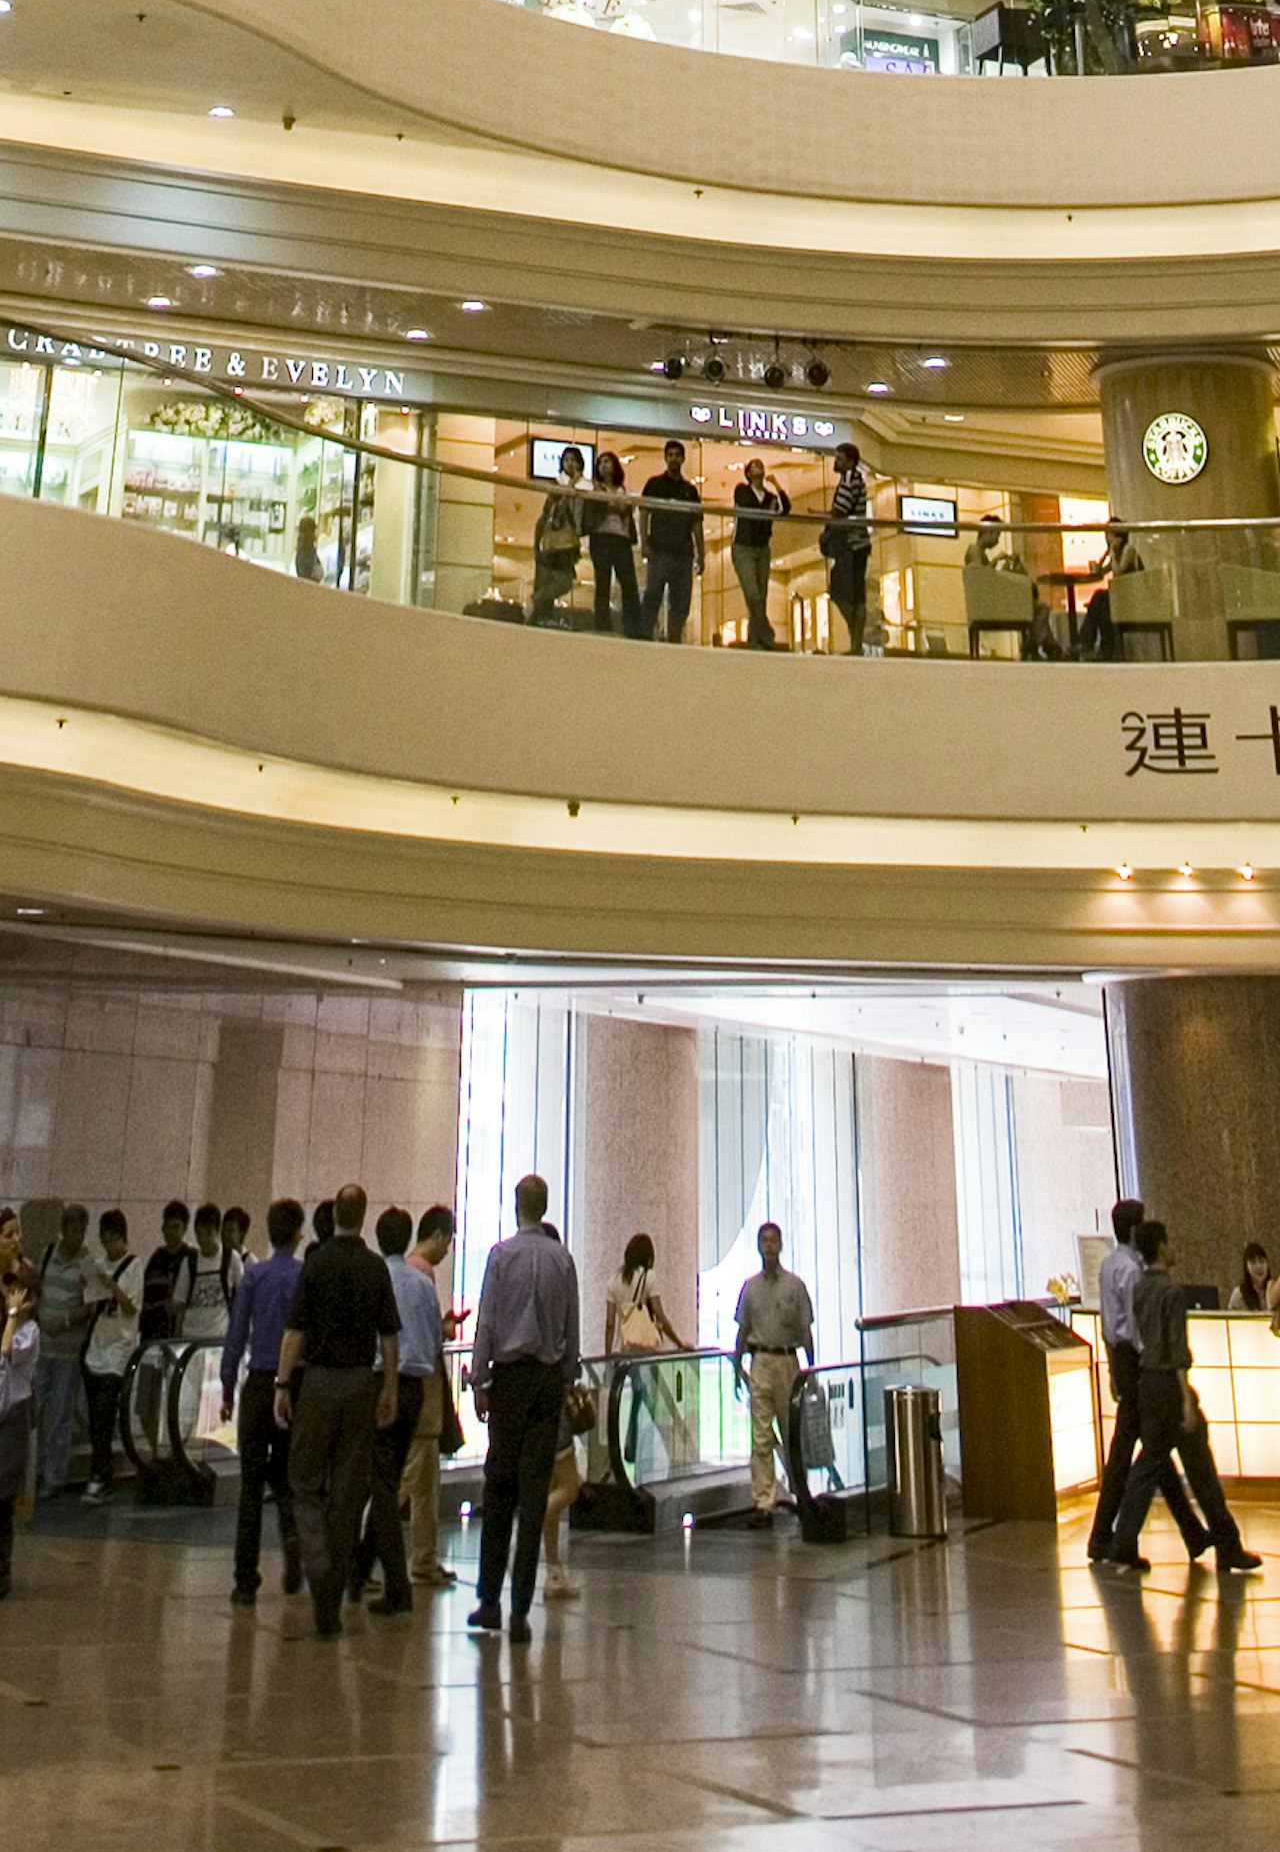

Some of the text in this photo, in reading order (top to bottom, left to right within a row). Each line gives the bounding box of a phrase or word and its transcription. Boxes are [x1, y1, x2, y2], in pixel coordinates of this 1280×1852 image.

[226, 352, 246, 376] &
[262, 356, 405, 395] EVELYN
[719, 407, 808, 437] LINKS
[1146, 414, 1203, 449] STARBUCKS
